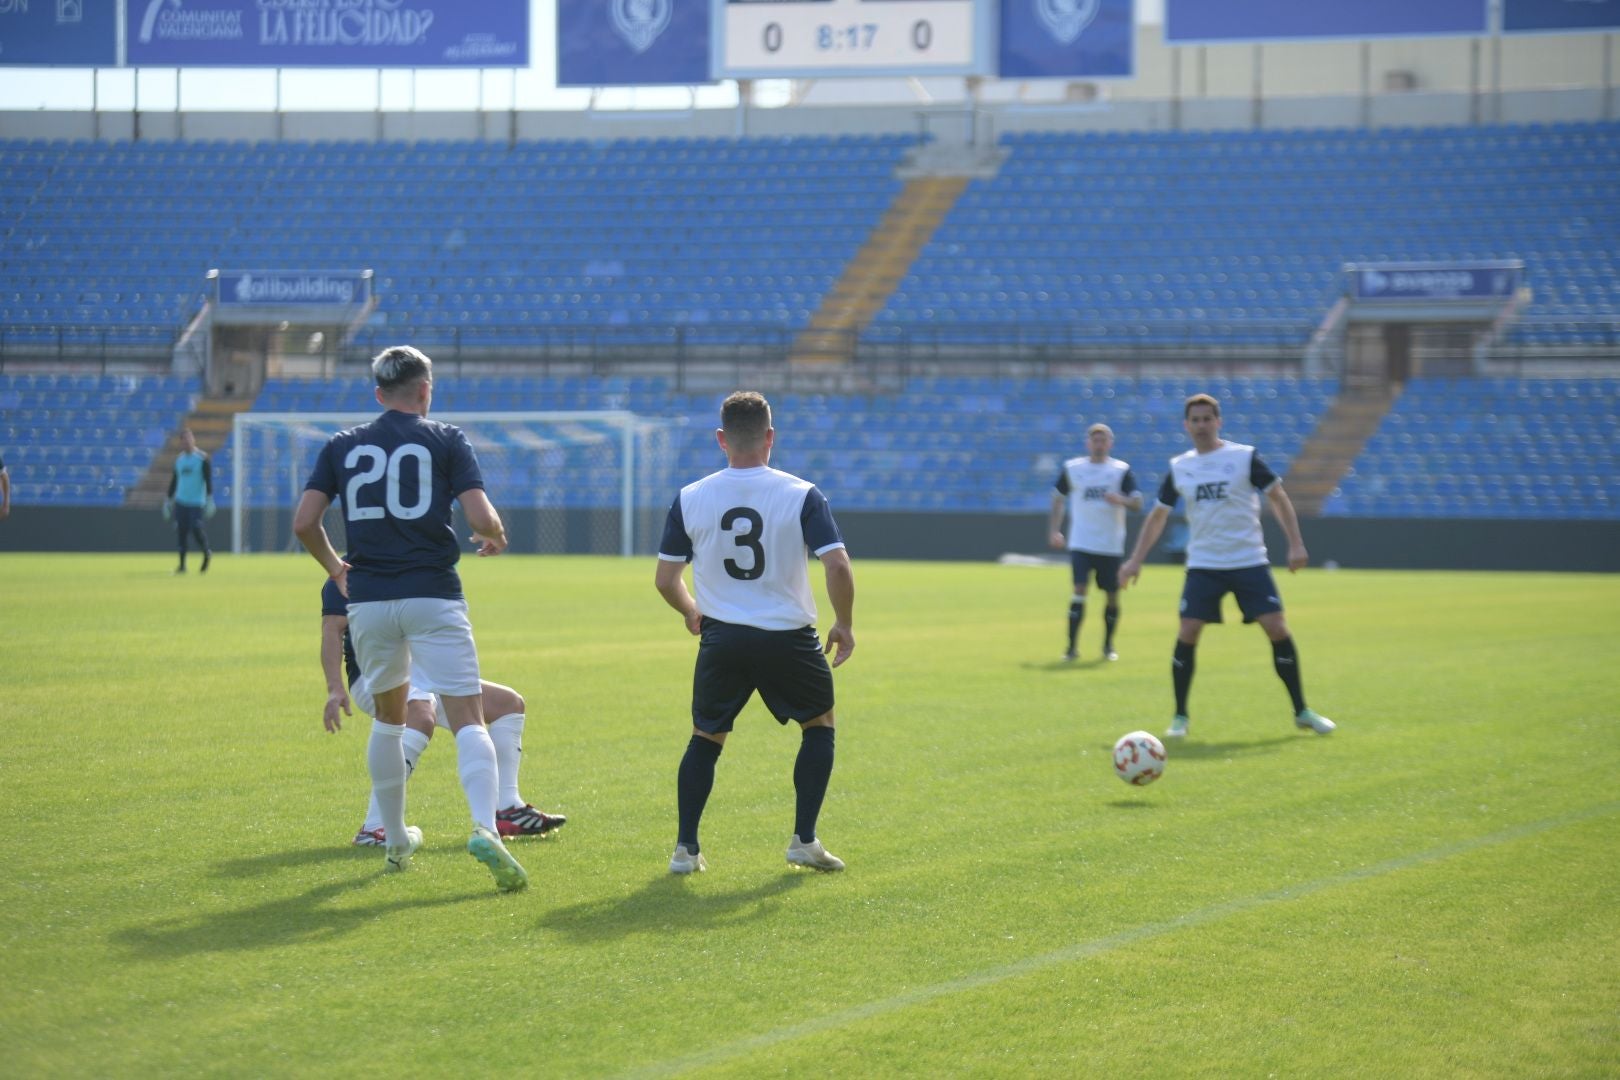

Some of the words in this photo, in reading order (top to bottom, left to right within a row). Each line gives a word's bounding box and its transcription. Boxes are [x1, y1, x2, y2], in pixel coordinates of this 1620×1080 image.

[158, 22, 243, 37] VALENCIANA
[160, 9, 243, 21] COMUNITAT
[259, 9, 288, 45] LA
[292, 8, 434, 46] FELICIDAD?
[763, 21, 783, 52] 0
[817, 23, 878, 50] 8:17
[912, 19, 932, 51] 0
[344, 443, 432, 522] 20
[721, 506, 765, 581] 3
